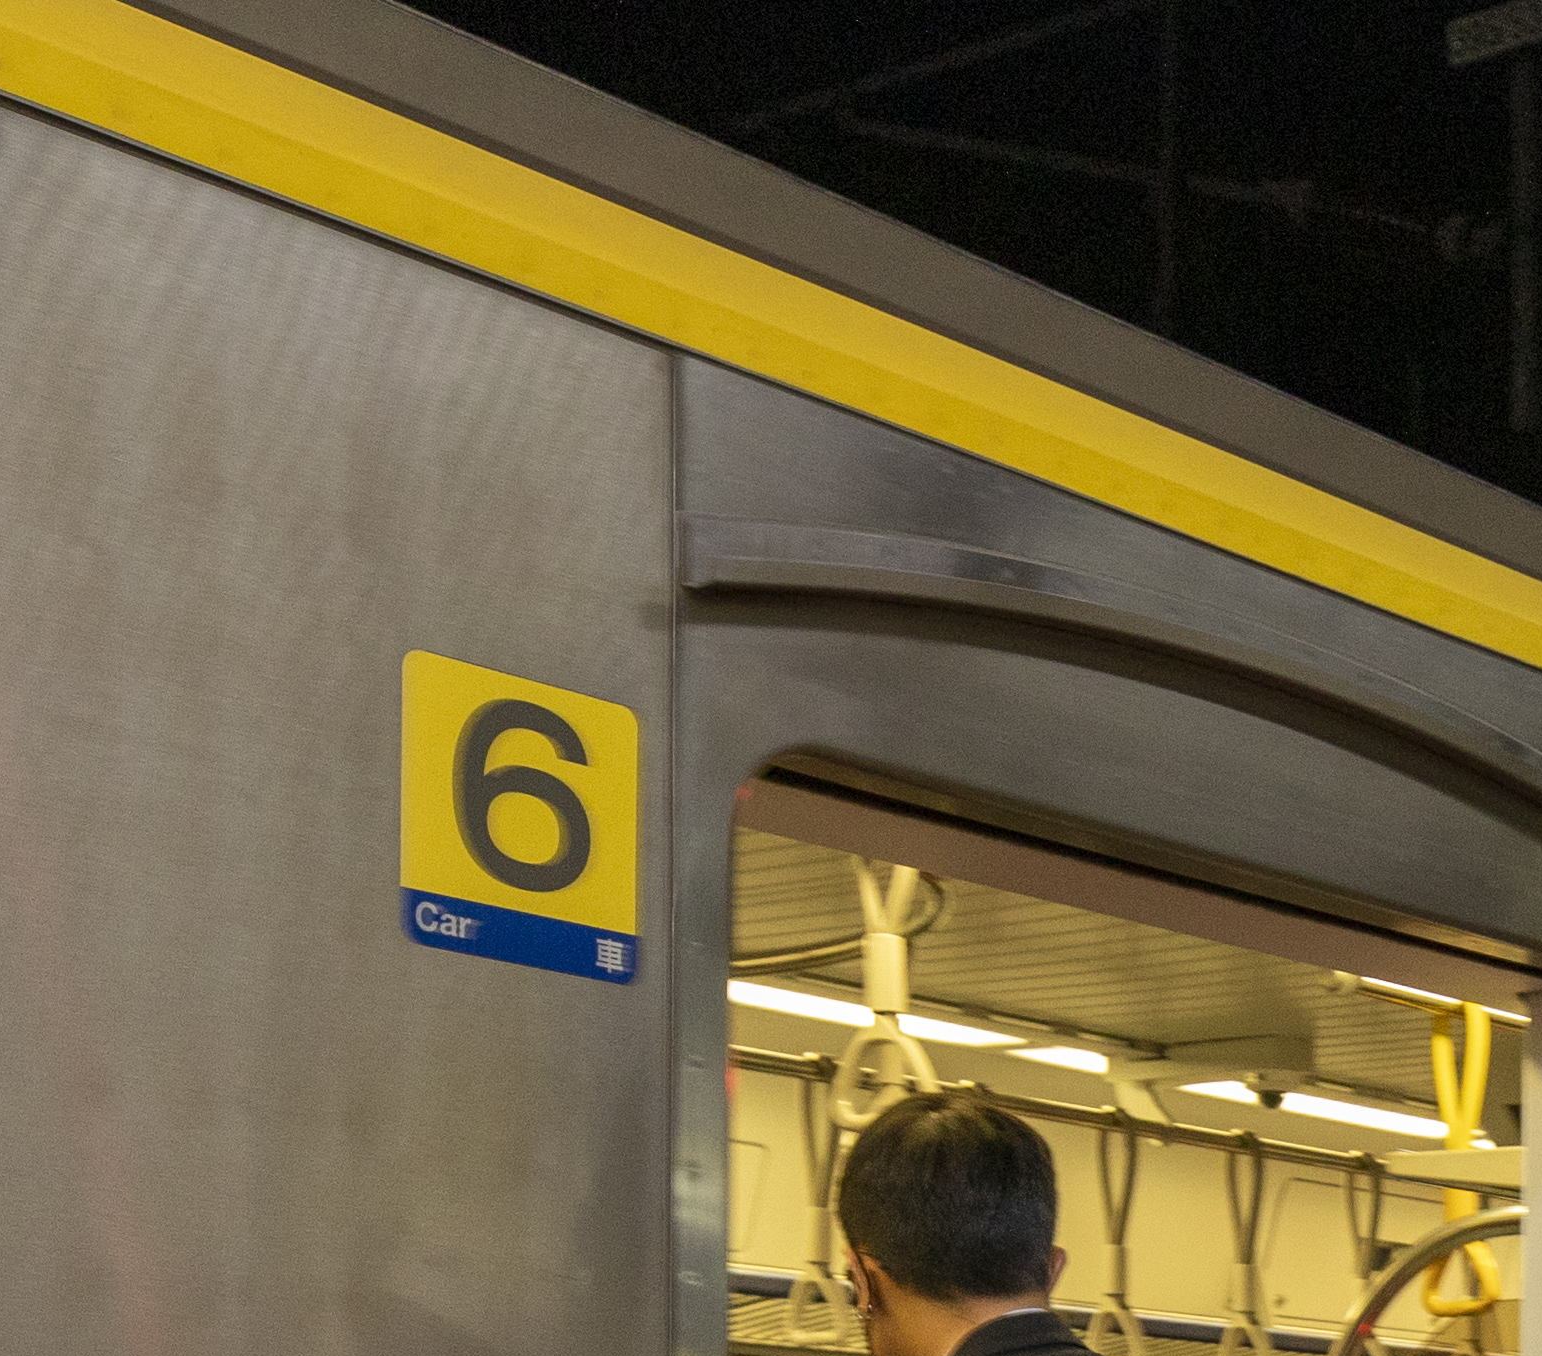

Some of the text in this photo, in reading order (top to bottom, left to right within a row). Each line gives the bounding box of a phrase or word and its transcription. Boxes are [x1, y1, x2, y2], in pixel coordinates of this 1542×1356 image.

[451, 697, 592, 893] 6
[415, 902, 474, 939] Car
[594, 938, 626, 974] 車
